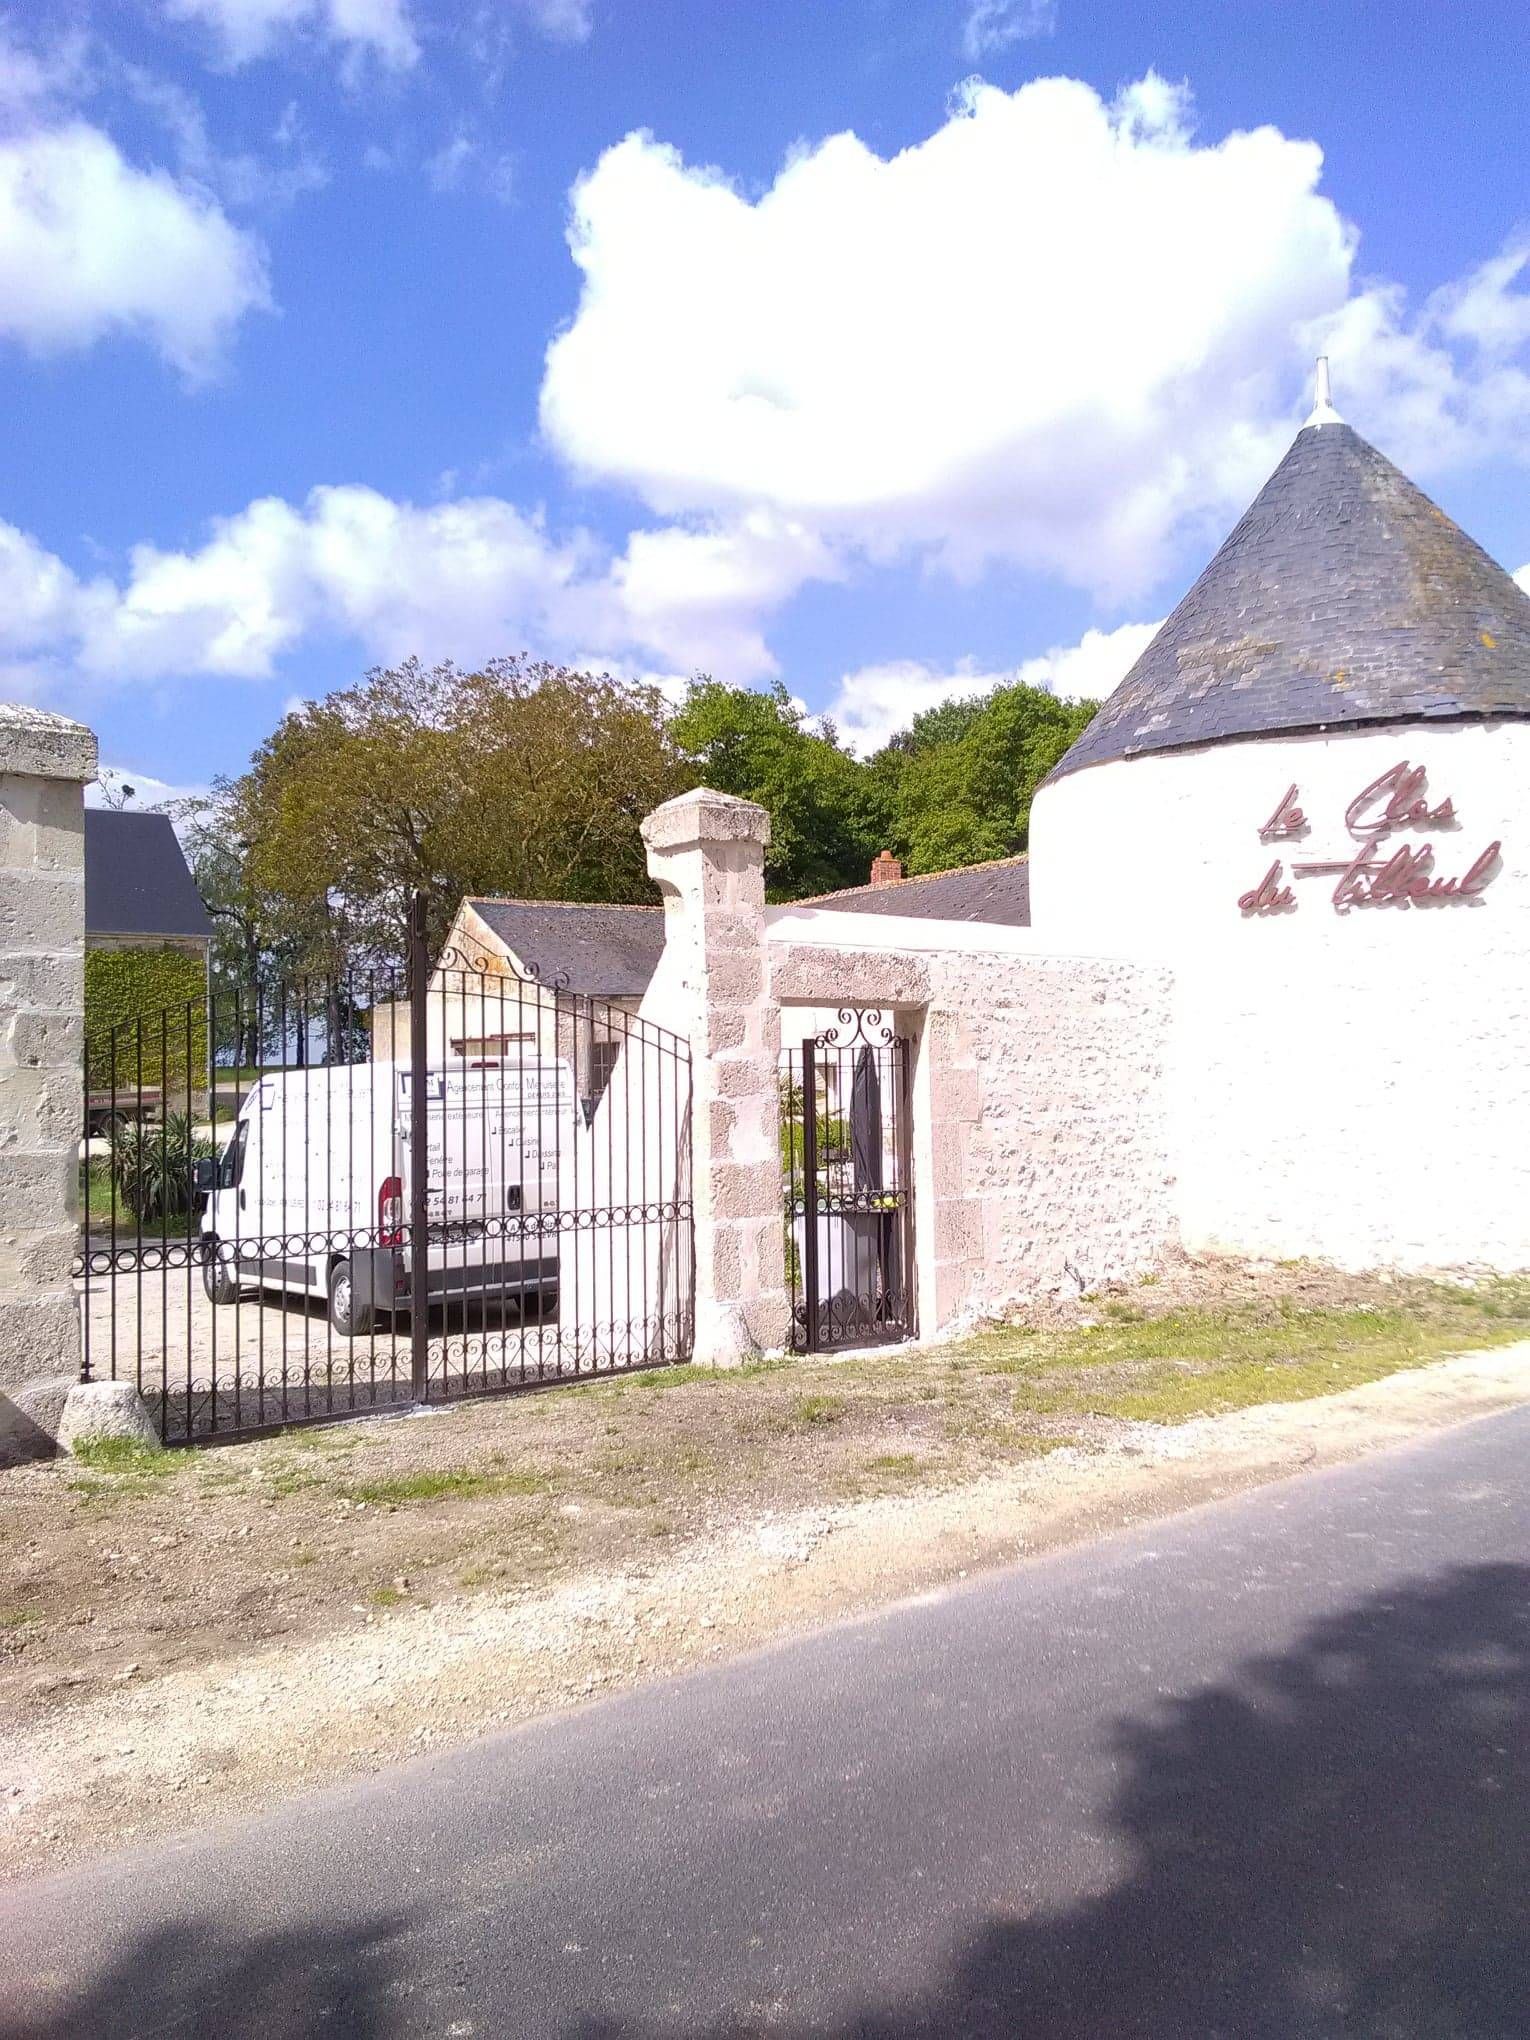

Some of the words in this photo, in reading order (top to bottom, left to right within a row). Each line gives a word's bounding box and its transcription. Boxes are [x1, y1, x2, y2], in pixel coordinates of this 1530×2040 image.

[1345, 761, 1457, 829] Clos
[1238, 859, 1296, 909] du
[1290, 838, 1501, 905] Tilleul
[447, 1079, 494, 1094] Agecemnt
[526, 1077, 566, 1090] Meuiseie
[464, 1167, 490, 1177] garae
